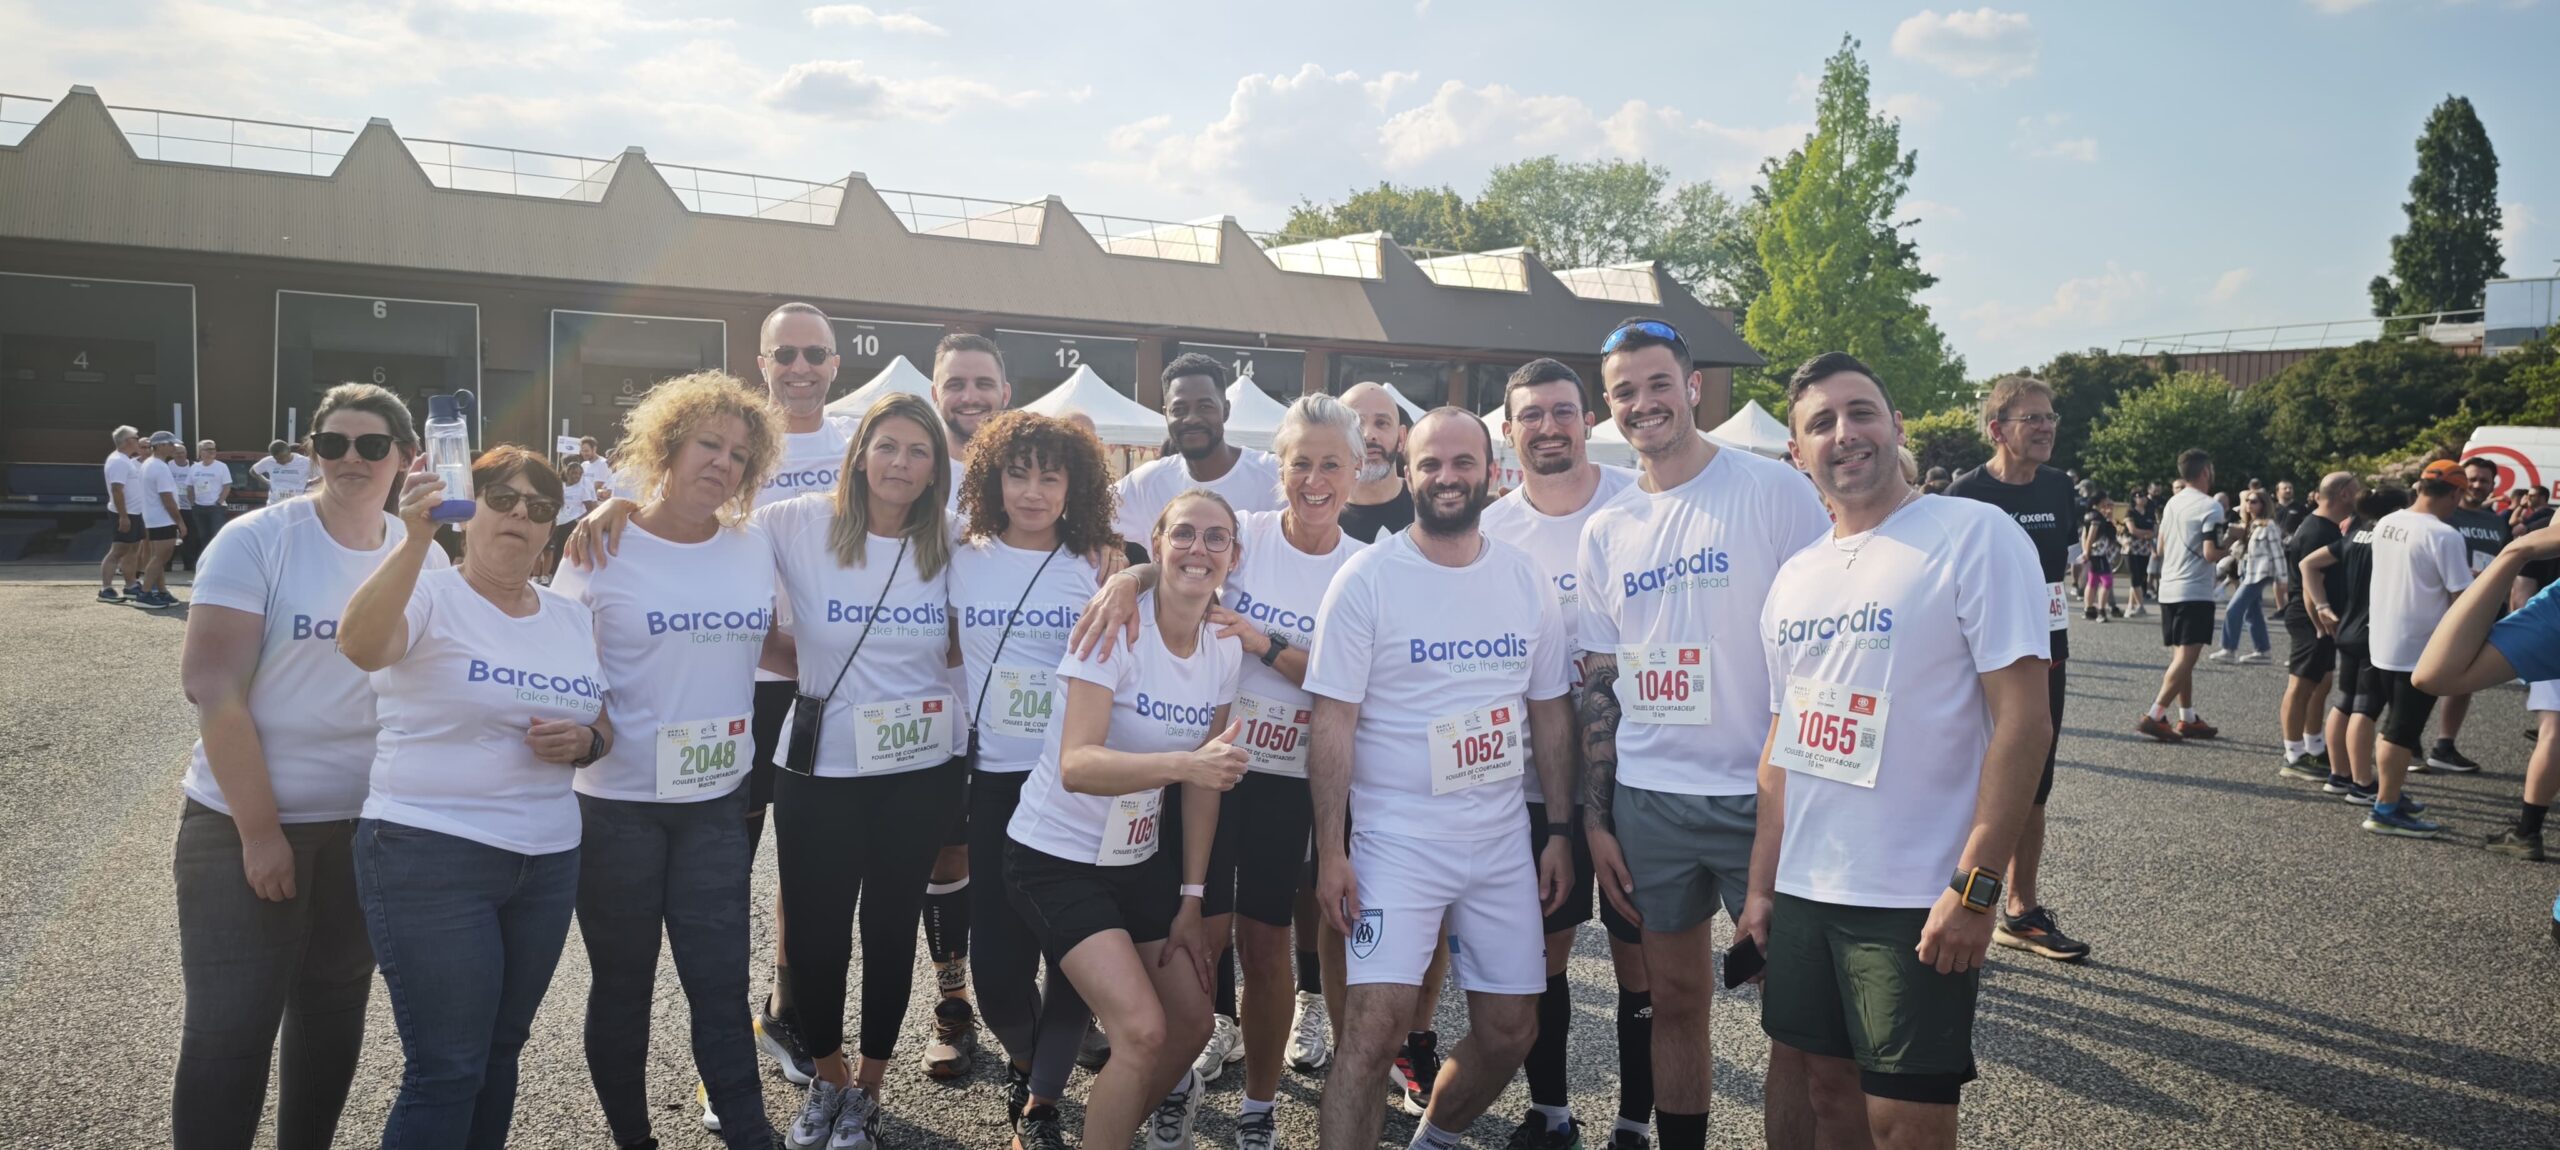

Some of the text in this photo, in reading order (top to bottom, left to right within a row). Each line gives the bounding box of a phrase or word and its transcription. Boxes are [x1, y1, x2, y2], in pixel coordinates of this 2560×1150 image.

[373, 300, 387, 318] 6
[852, 334, 879, 356] 10
[73, 351, 89, 369] 4
[1055, 347, 1081, 369] 12
[1232, 358, 1255, 379] 14
[372, 366, 387, 384] 6
[622, 378, 634, 395] 8
[2459, 527, 2500, 542] NICOLAS
[1697, 575, 1730, 589] lead
[827, 600, 945, 625] Barcodis
[1234, 591, 1315, 633] Barco
[2049, 598, 2063, 617] 46
[896, 623, 919, 637] the
[922, 624, 946, 637] lead
[1029, 628, 1051, 640] the
[1778, 601, 1893, 647] Barcodis
[690, 632, 722, 645] Take
[726, 630, 749, 642] the
[1410, 632, 1528, 664] Barcodis
[1855, 635, 1891, 651] lead
[1447, 658, 1527, 674] Take the lead
[1634, 669, 1690, 702] 1046
[514, 687, 550, 705] Take
[554, 694, 580, 709] the
[1008, 688, 1053, 719] 204
[876, 716, 933, 752] 2047
[1164, 722, 1187, 737] Take
[1245, 718, 1299, 753] 1050
[1797, 709, 1858, 755] 1055
[680, 740, 737, 776] 2048
[1452, 729, 1505, 769] 1052
